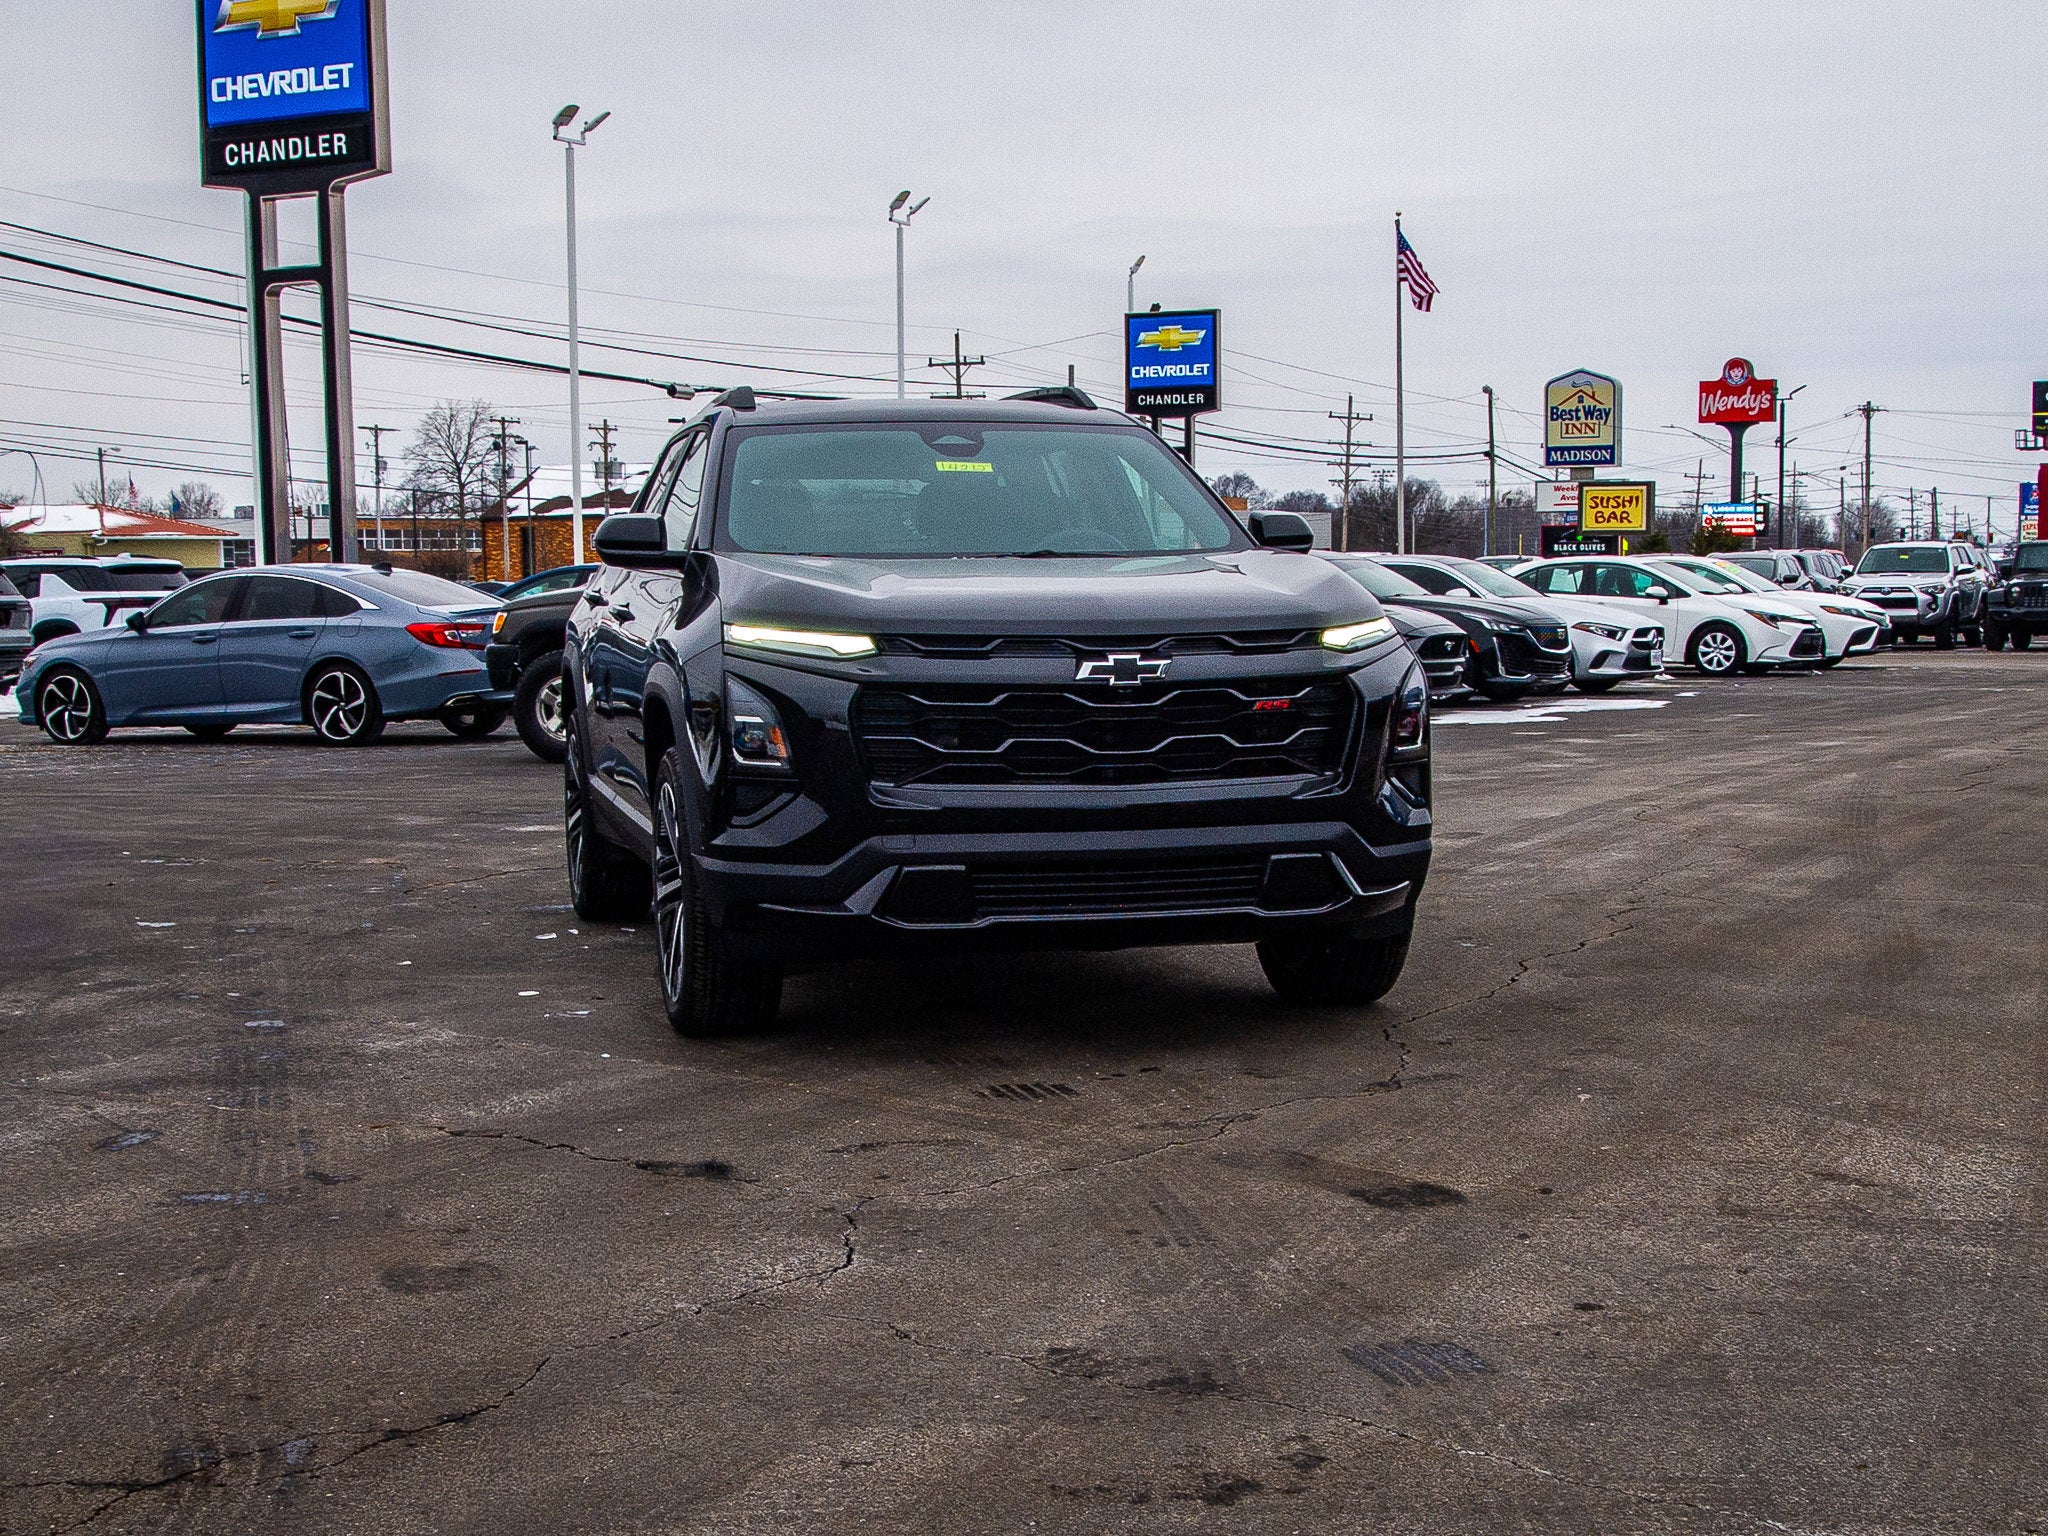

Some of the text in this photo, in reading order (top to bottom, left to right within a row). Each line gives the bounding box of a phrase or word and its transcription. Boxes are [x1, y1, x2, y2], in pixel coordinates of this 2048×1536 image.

[211, 62, 354, 102] CHEVROLET
[225, 133, 348, 166] CHANDLER
[1131, 363, 1210, 378] CHEVROLET
[1137, 394, 1204, 406] CHANDLER
[1701, 386, 1771, 417] Wendy's
[1550, 404, 1612, 426] Best Way
[1563, 422, 1597, 435] INN
[1550, 449, 1611, 462] MADISON
[1588, 495, 1640, 510] SUSHI
[1594, 511, 1633, 524] BAR
[1553, 543, 1606, 552] BLACK OLIVES
[1253, 699, 1289, 710] RS
